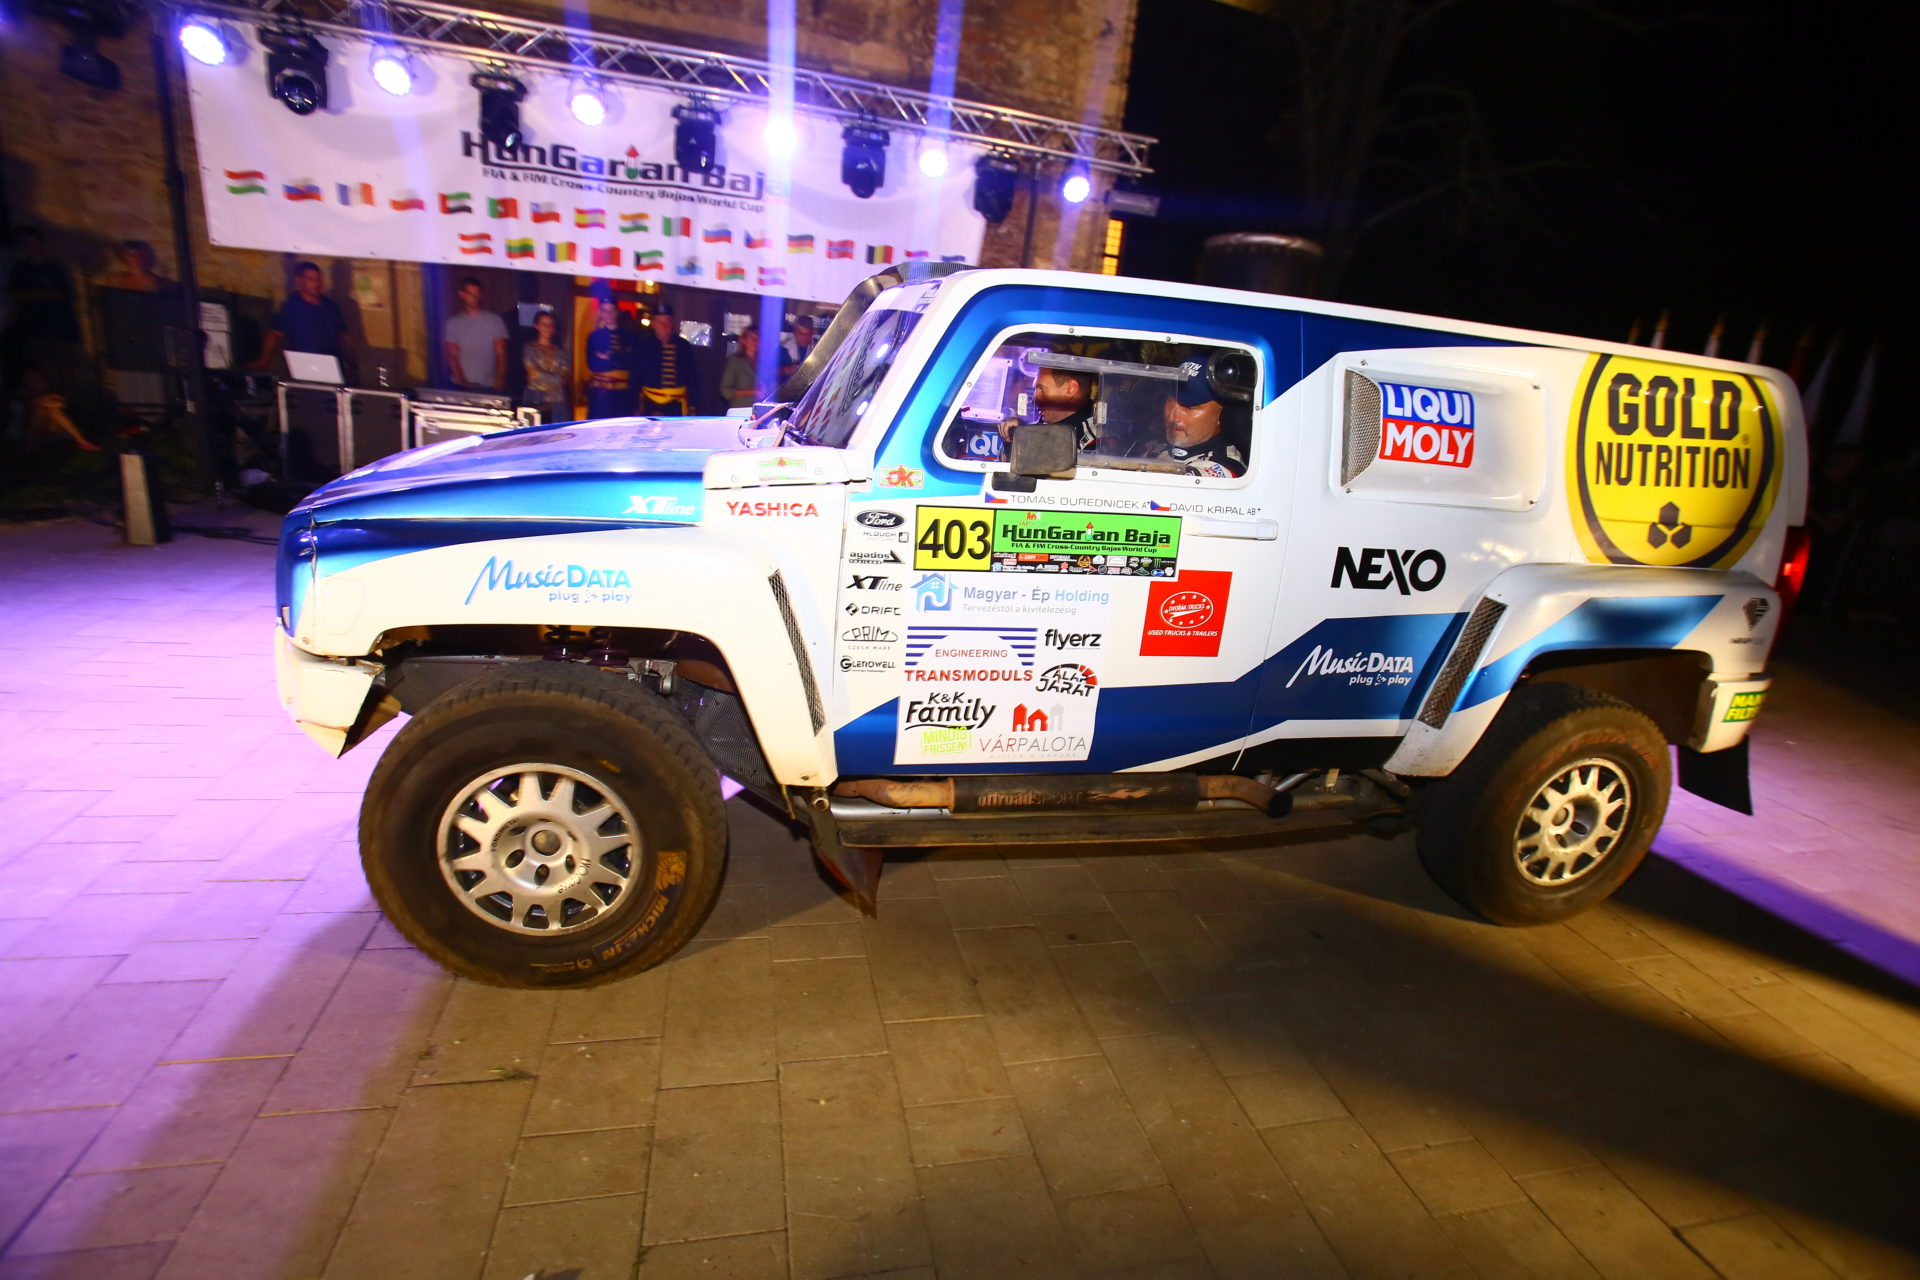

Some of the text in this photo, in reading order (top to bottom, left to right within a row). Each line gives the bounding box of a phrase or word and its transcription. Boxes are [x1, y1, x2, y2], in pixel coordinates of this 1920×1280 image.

[1383, 384, 1472, 425] LIQUI
[1608, 372, 1742, 441] GOLD
[1383, 422, 1473, 464] MOLY
[1595, 441, 1750, 490] NUTRITION
[726, 500, 820, 518] YASHICA
[1010, 494, 1056, 505] TOMAS
[1060, 496, 1140, 510] OUREDNICEK
[1169, 502, 1204, 514] DAVID
[1207, 504, 1244, 517] KRIPAL
[866, 512, 897, 526] Ford
[918, 518, 991, 560] 403
[1125, 528, 1171, 547] Baja
[849, 551, 890, 561] agados
[1047, 543, 1100, 552] Cross-Country
[1330, 546, 1447, 596] NEXO
[846, 574, 903, 592] XTline
[549, 590, 632, 604] plug play
[963, 586, 1019, 603] Magyar
[1031, 586, 1050, 604] Ép
[1055, 589, 1110, 605] Holding
[851, 625, 891, 642] PRIM
[1045, 629, 1102, 651] flyerz
[935, 649, 1008, 659] ENGINEERING
[904, 669, 1034, 682] TRANSMODULS
[1348, 674, 1412, 686] plug play
[928, 691, 966, 705] K&K
[905, 698, 997, 729] Family
[979, 734, 1087, 752] VÁRPALOTA
